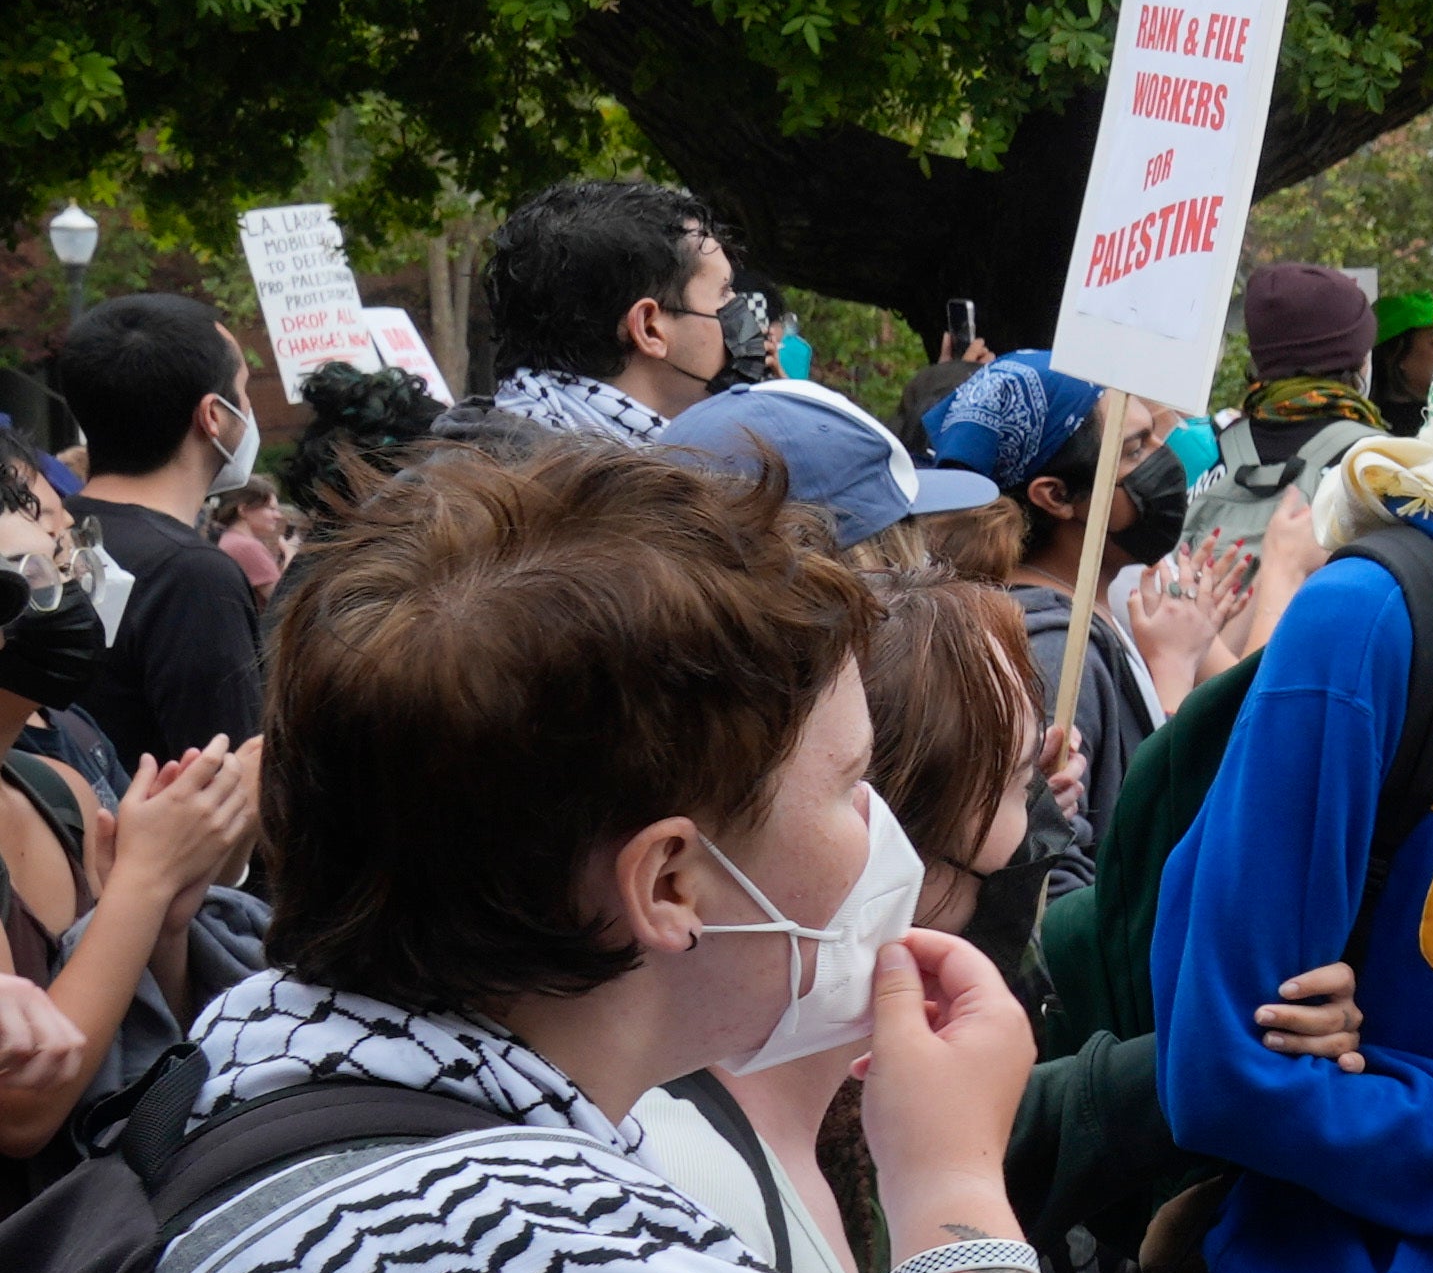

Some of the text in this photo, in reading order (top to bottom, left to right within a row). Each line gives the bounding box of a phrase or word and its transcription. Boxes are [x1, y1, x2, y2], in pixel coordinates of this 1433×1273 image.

[1136, 4, 1251, 64] RANK & FILE
[1132, 71, 1227, 131] WORKERS
[1143, 148, 1174, 192] FOR
[1085, 195, 1224, 288] PALESTINE
[267, 261, 286, 275] TO
[281, 308, 356, 334] DROP ALL
[277, 333, 345, 358] CHARGES
